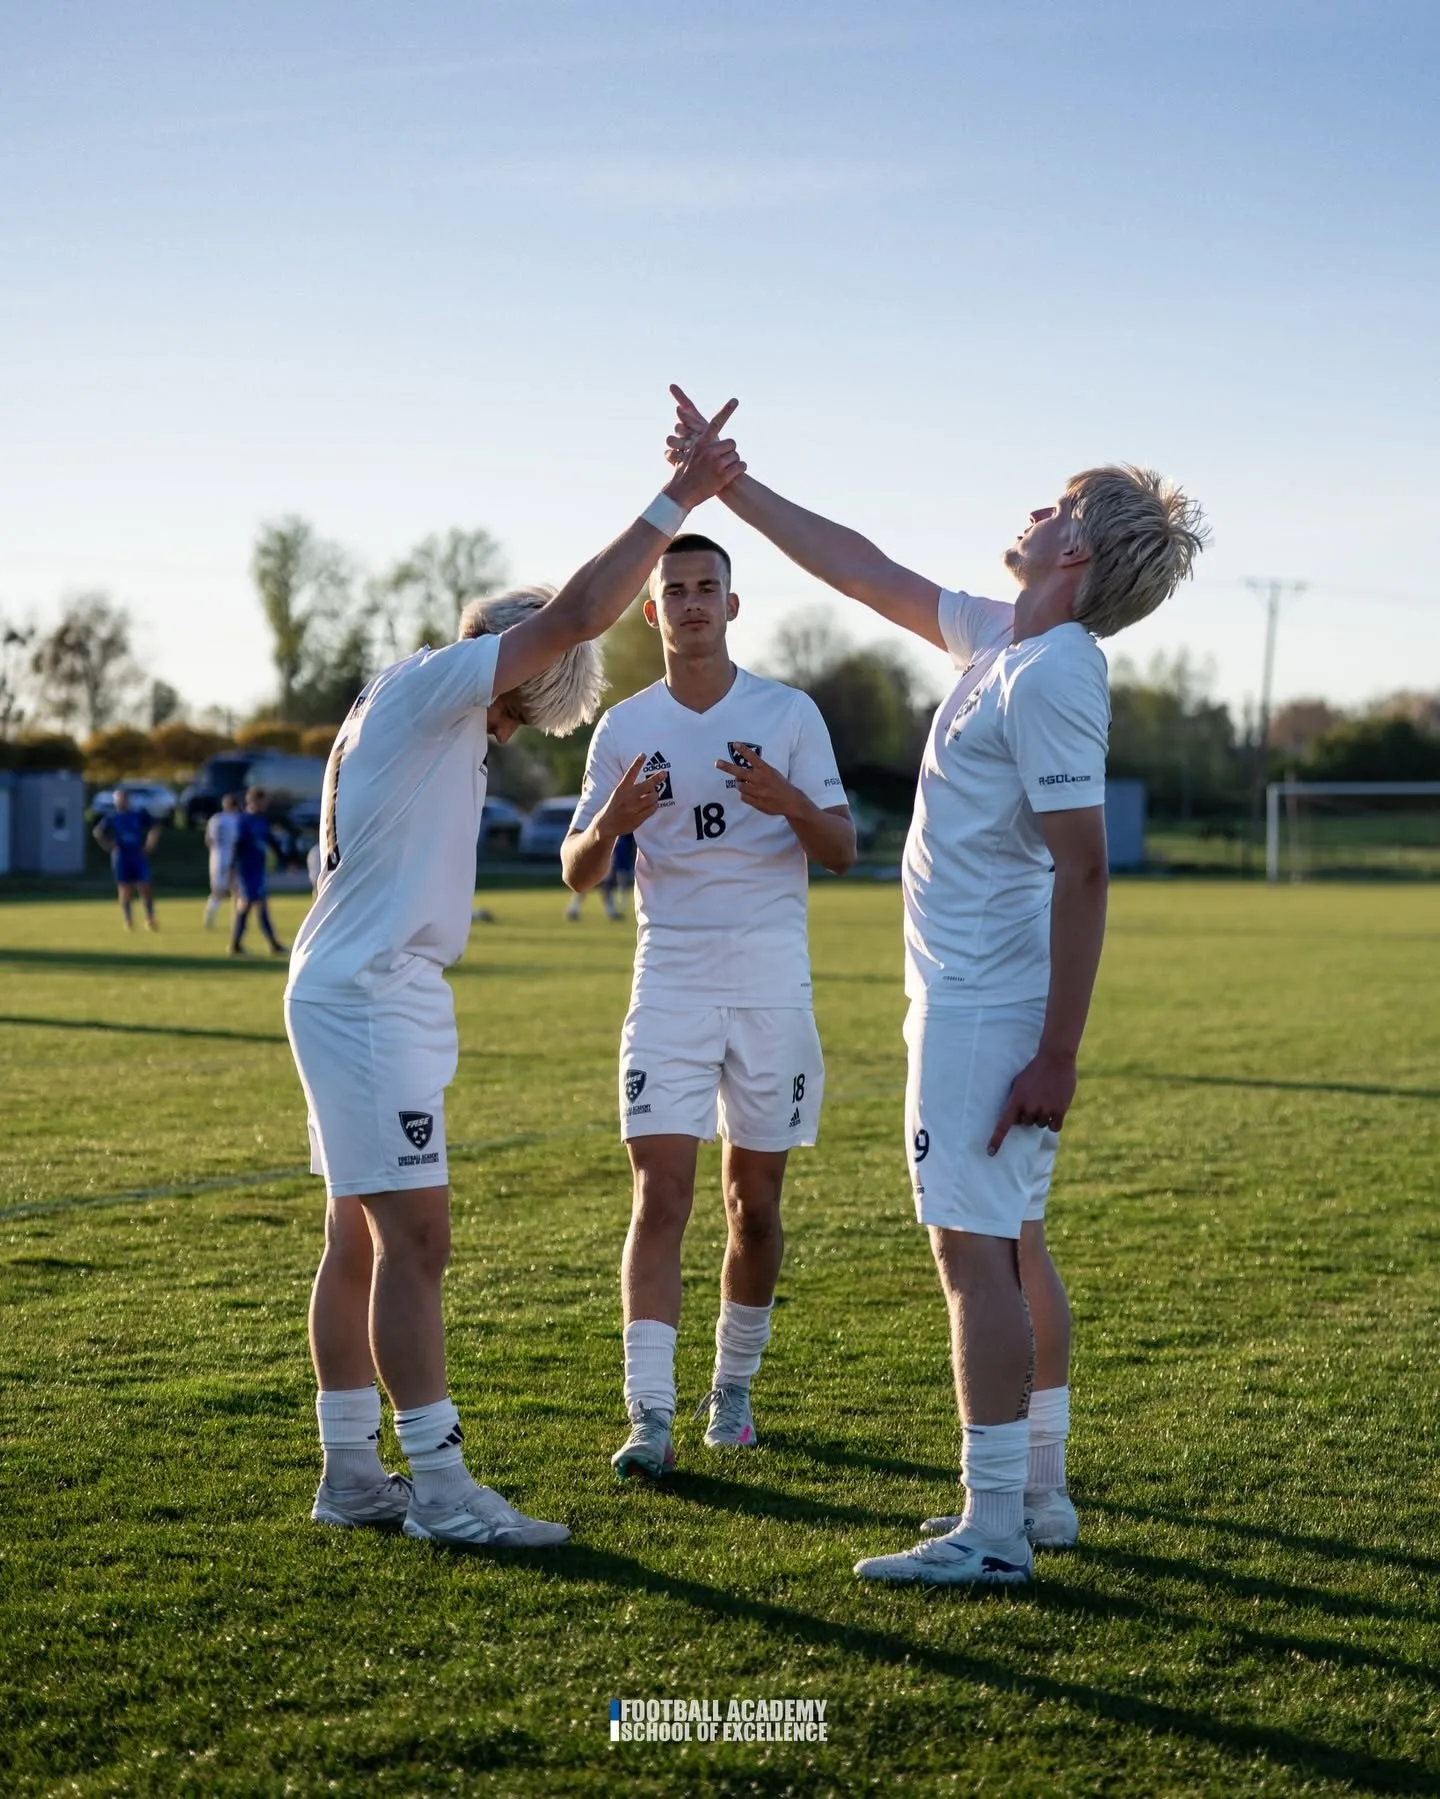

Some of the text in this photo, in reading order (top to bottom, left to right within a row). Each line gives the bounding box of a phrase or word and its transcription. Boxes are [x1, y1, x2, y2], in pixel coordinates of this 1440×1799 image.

[642, 761, 671, 772] adidas
[694, 802, 726, 840] 18
[792, 1073, 805, 1103] 18
[915, 1129, 930, 1163] 9
